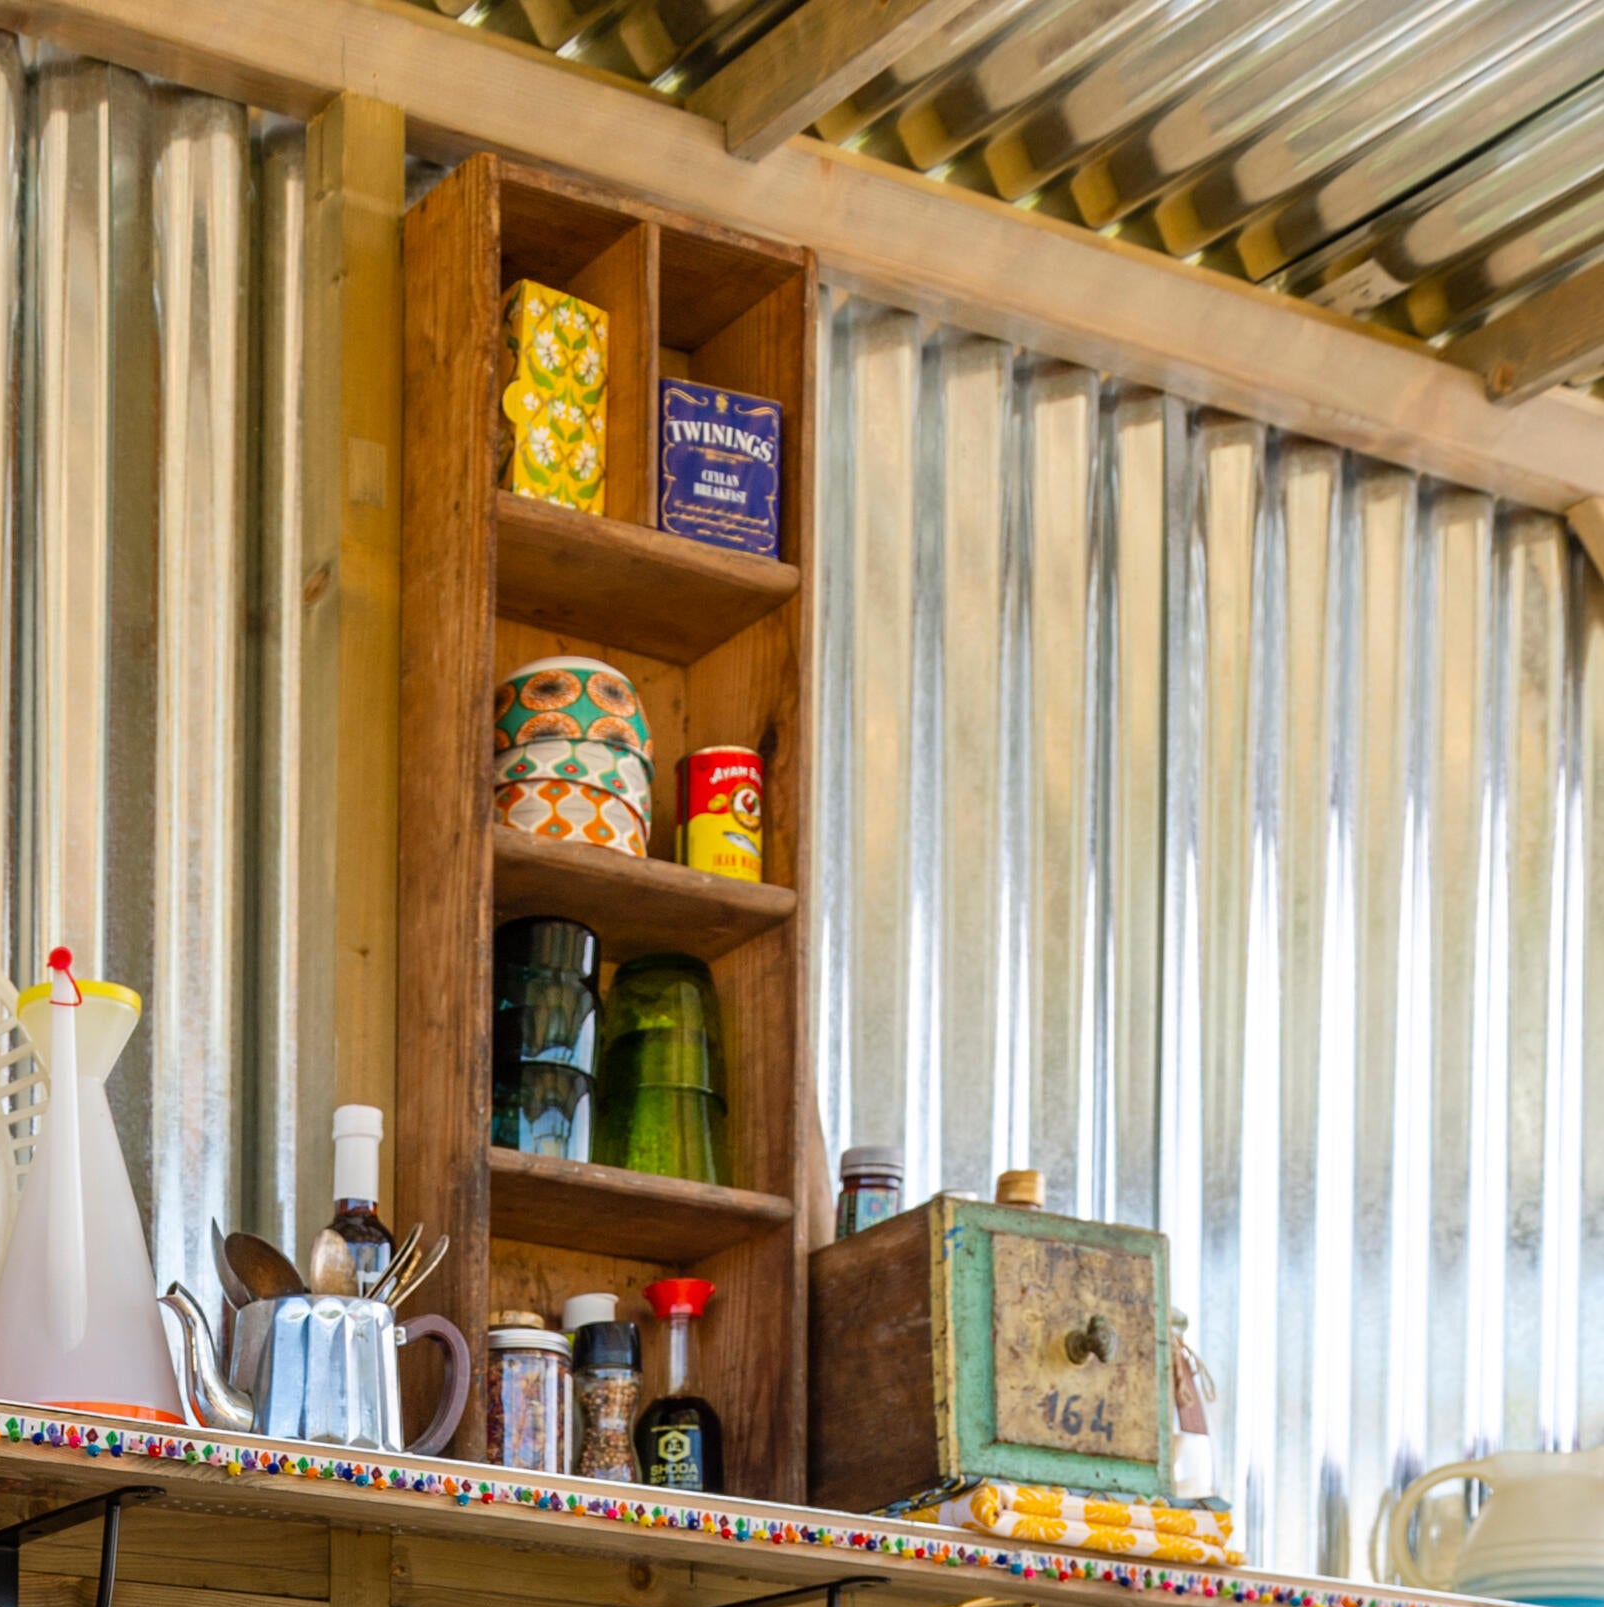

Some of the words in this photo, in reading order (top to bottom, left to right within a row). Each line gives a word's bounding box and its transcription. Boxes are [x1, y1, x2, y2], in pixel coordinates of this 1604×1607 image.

[669, 420, 774, 462] TWININGS
[693, 482, 747, 504] BREAKFAST
[709, 765, 748, 785] AYAM
[1037, 1391, 1114, 1441] 164
[650, 1463, 699, 1477] SHODA
